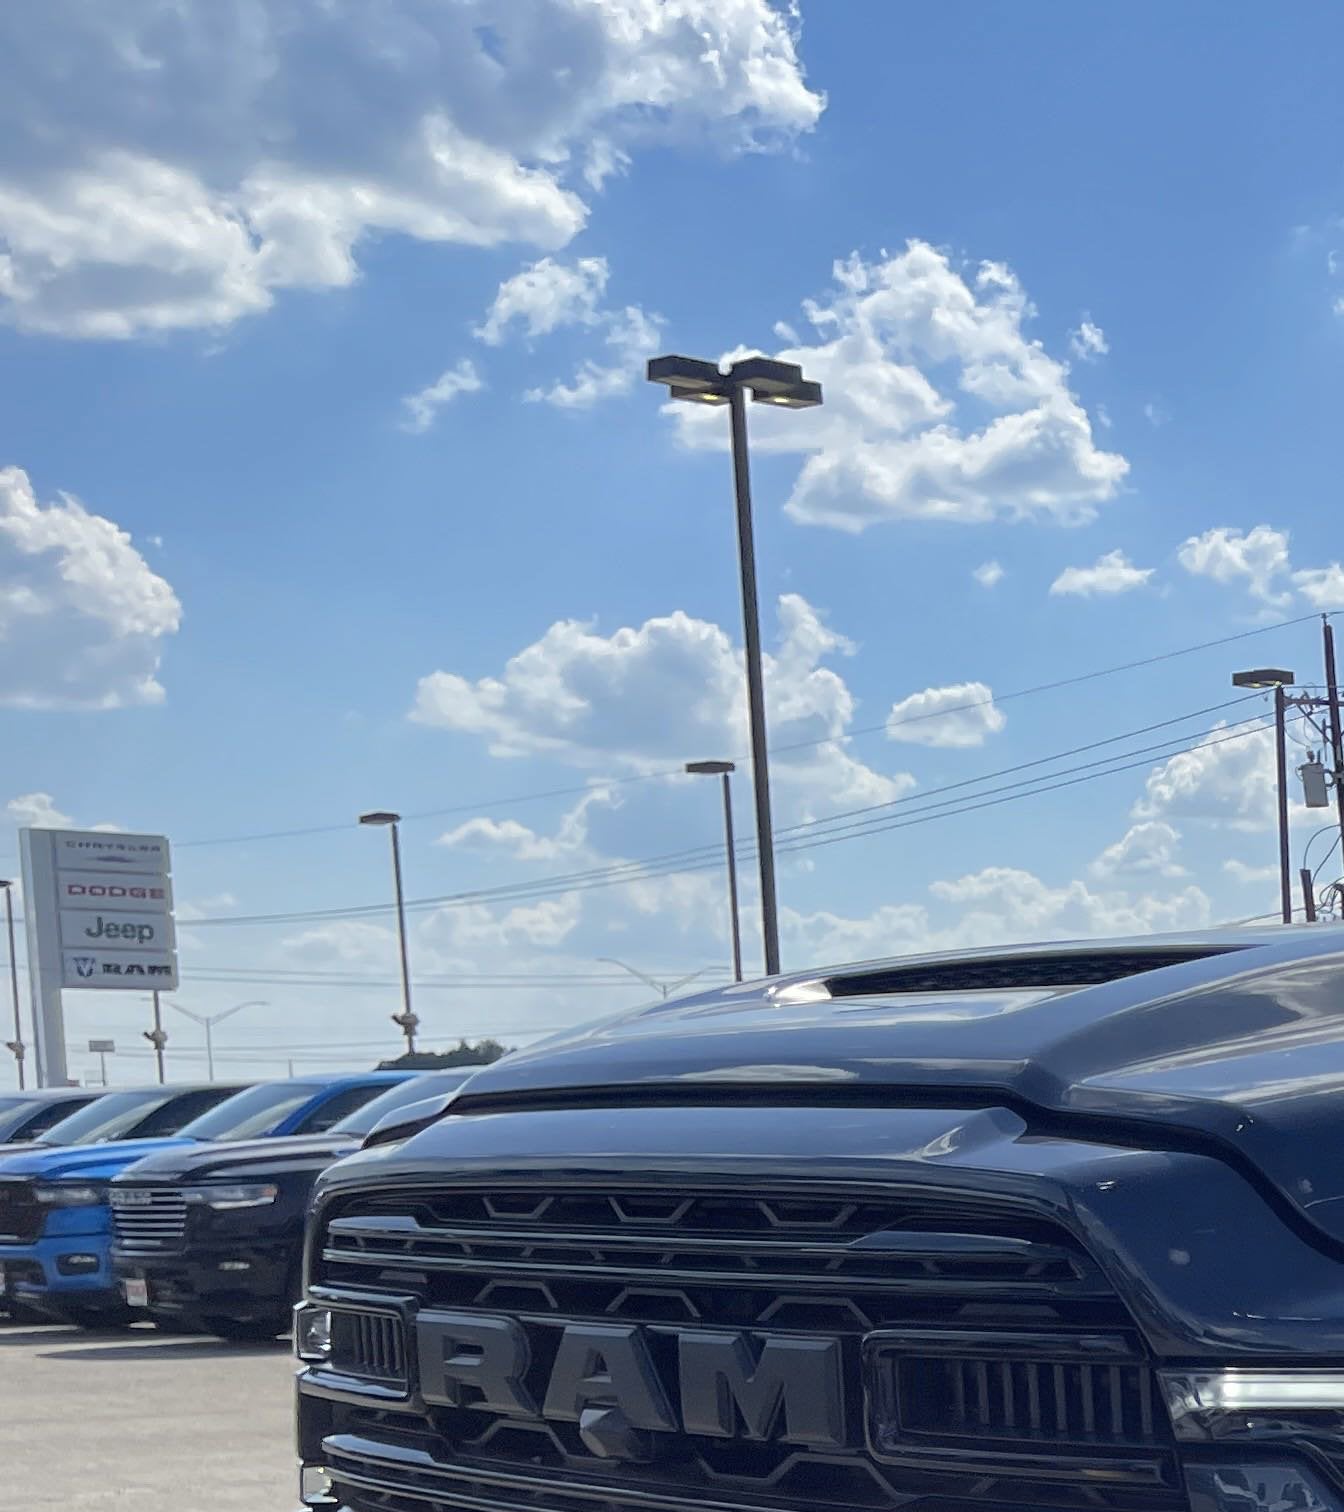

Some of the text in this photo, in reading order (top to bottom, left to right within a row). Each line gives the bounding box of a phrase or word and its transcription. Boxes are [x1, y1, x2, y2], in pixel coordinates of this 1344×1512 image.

[67, 884, 165, 899] DODGE
[85, 916, 154, 944] Jeep
[416, 1307, 846, 1448] RAM
